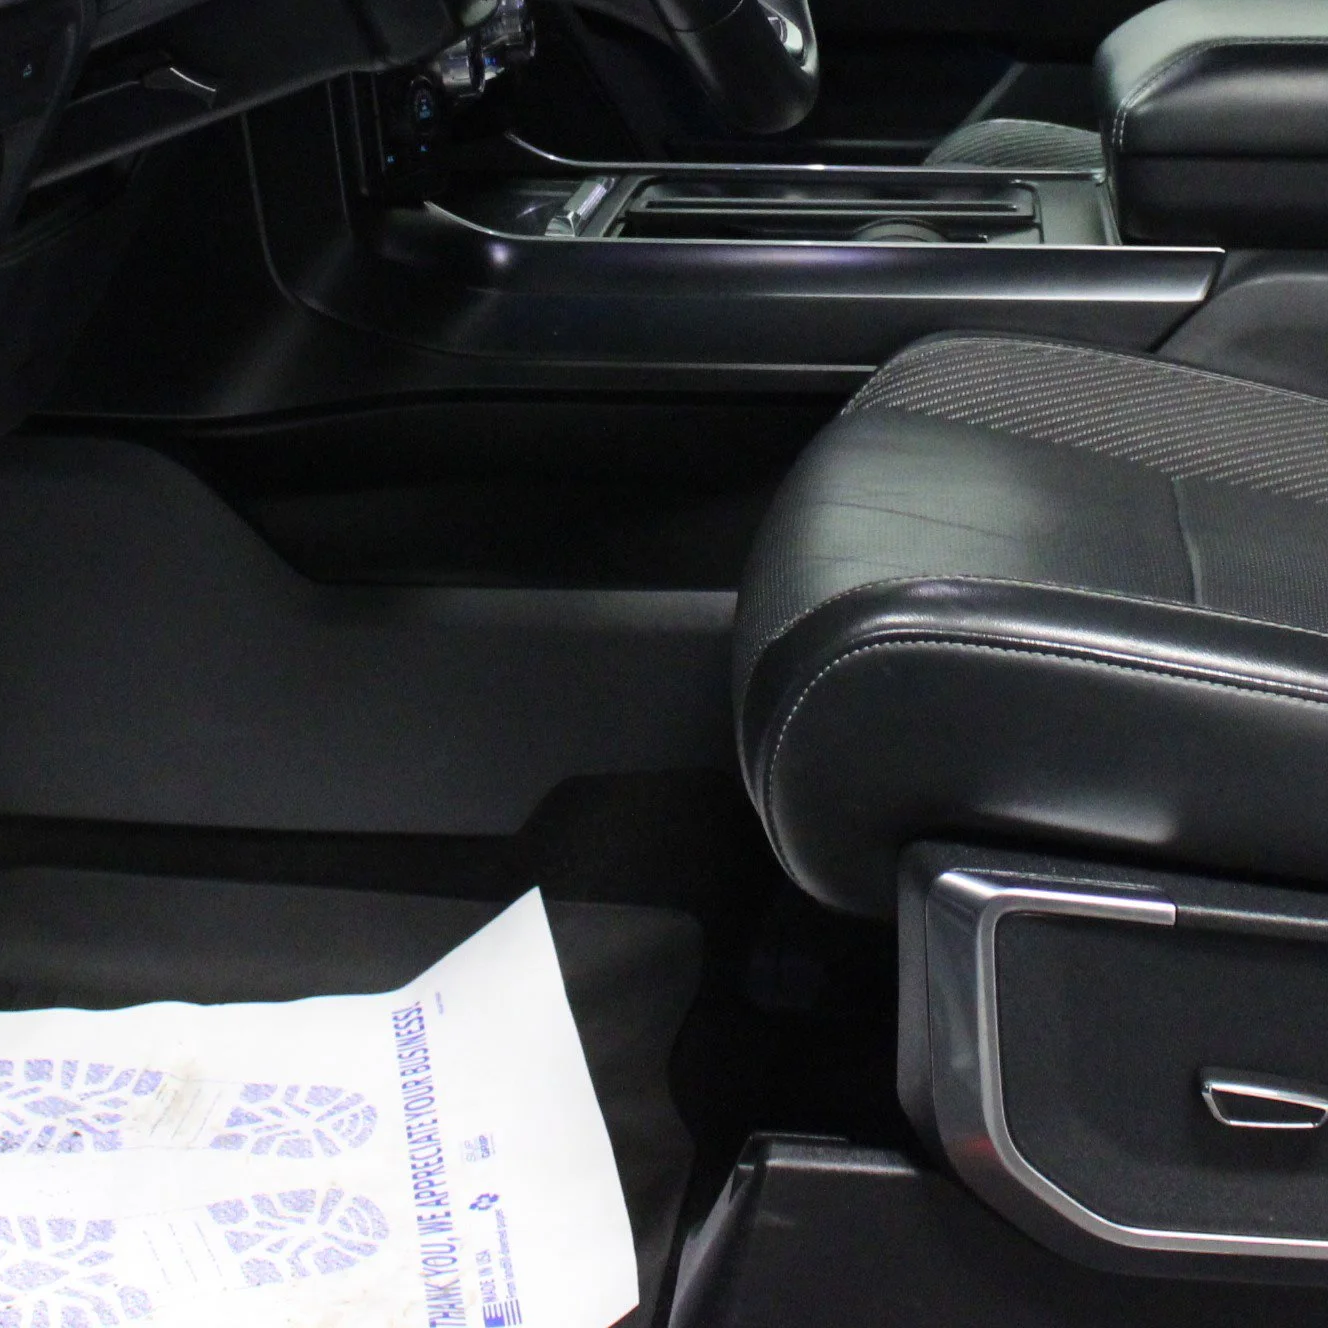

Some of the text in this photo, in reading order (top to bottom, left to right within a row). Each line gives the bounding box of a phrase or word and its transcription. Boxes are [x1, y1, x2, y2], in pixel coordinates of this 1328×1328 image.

[391, 1000, 467, 1328] THANK YOU, WE APPRECIATE YOUR BUSINESS!
[479, 1278, 497, 1304] MADE
